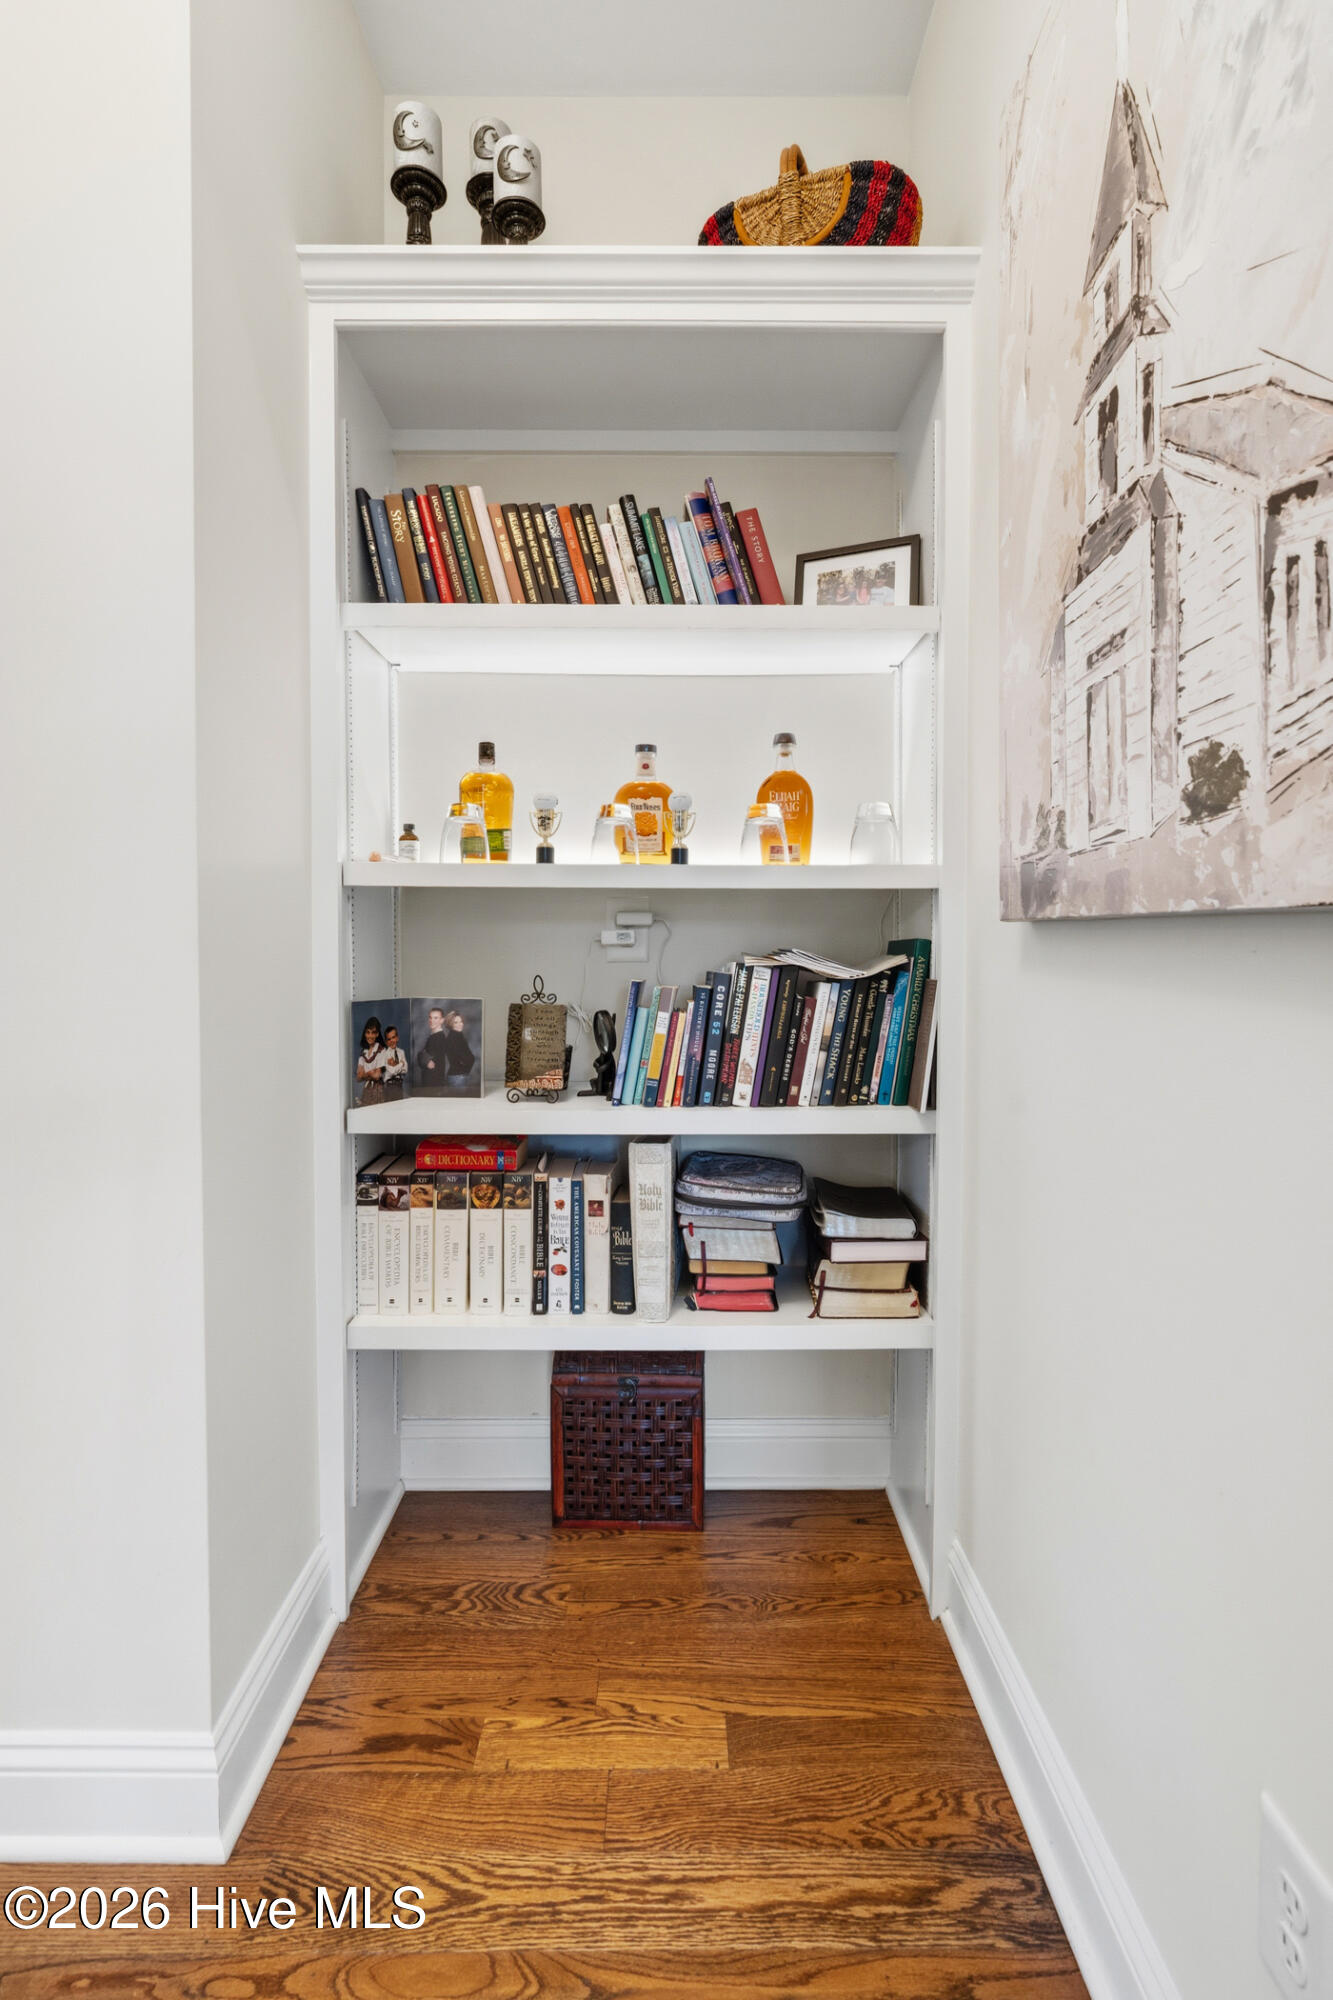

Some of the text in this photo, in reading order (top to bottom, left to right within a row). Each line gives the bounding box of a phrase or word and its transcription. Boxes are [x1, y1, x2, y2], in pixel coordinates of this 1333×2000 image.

[431, 495, 444, 523] LUCADO
[701, 514, 717, 537] TOM
[624, 501, 646, 553] SUMMIT LAKE
[744, 516, 767, 564] THE STORY
[455, 534, 468, 558] LIGHT
[707, 537, 732, 584] BROKAW
[769, 791, 800, 801] ELIJAH
[917, 955, 926, 964] A
[711, 985, 726, 1036] CORE 52
[729, 969, 748, 1036] JAMES PATTERSON
[753, 983, 767, 1032] HOUSEHOLD
[837, 988, 851, 1023] YOUNG
[907, 993, 921, 1042] CHRISTMAS
[705, 1049, 717, 1080] MOORE
[826, 1031, 842, 1081] THE SHACK
[438, 1153, 495, 1166] DICTIONARY
[638, 1183, 663, 1197] Holy
[639, 1198, 663, 1211] Bible
